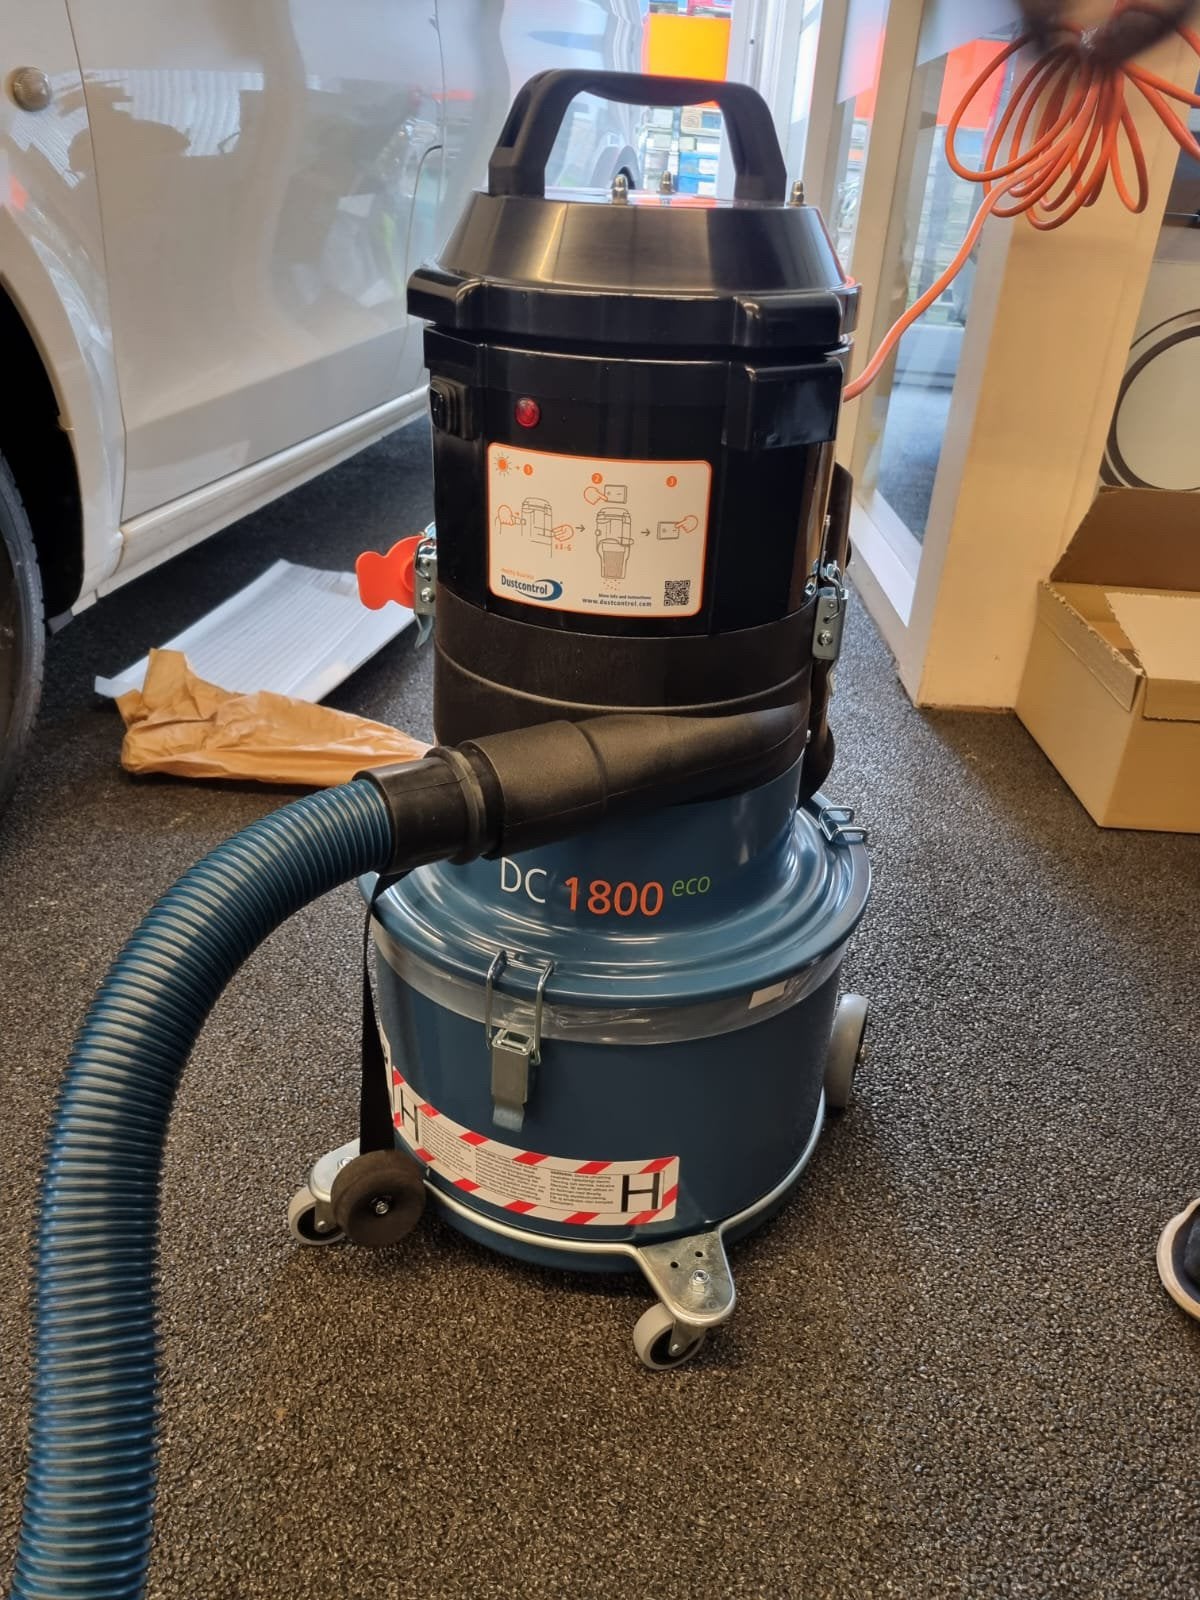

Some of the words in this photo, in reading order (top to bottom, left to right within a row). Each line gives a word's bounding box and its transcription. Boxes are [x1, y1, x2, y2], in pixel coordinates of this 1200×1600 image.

[500, 574, 548, 595] Dustcontrol
[582, 597, 652, 608] www.dustcontrol.com
[500, 856, 547, 904] DC
[564, 875, 665, 918] 1800
[671, 875, 711, 897] eco
[399, 1087, 419, 1142] H
[620, 1171, 661, 1213] H
